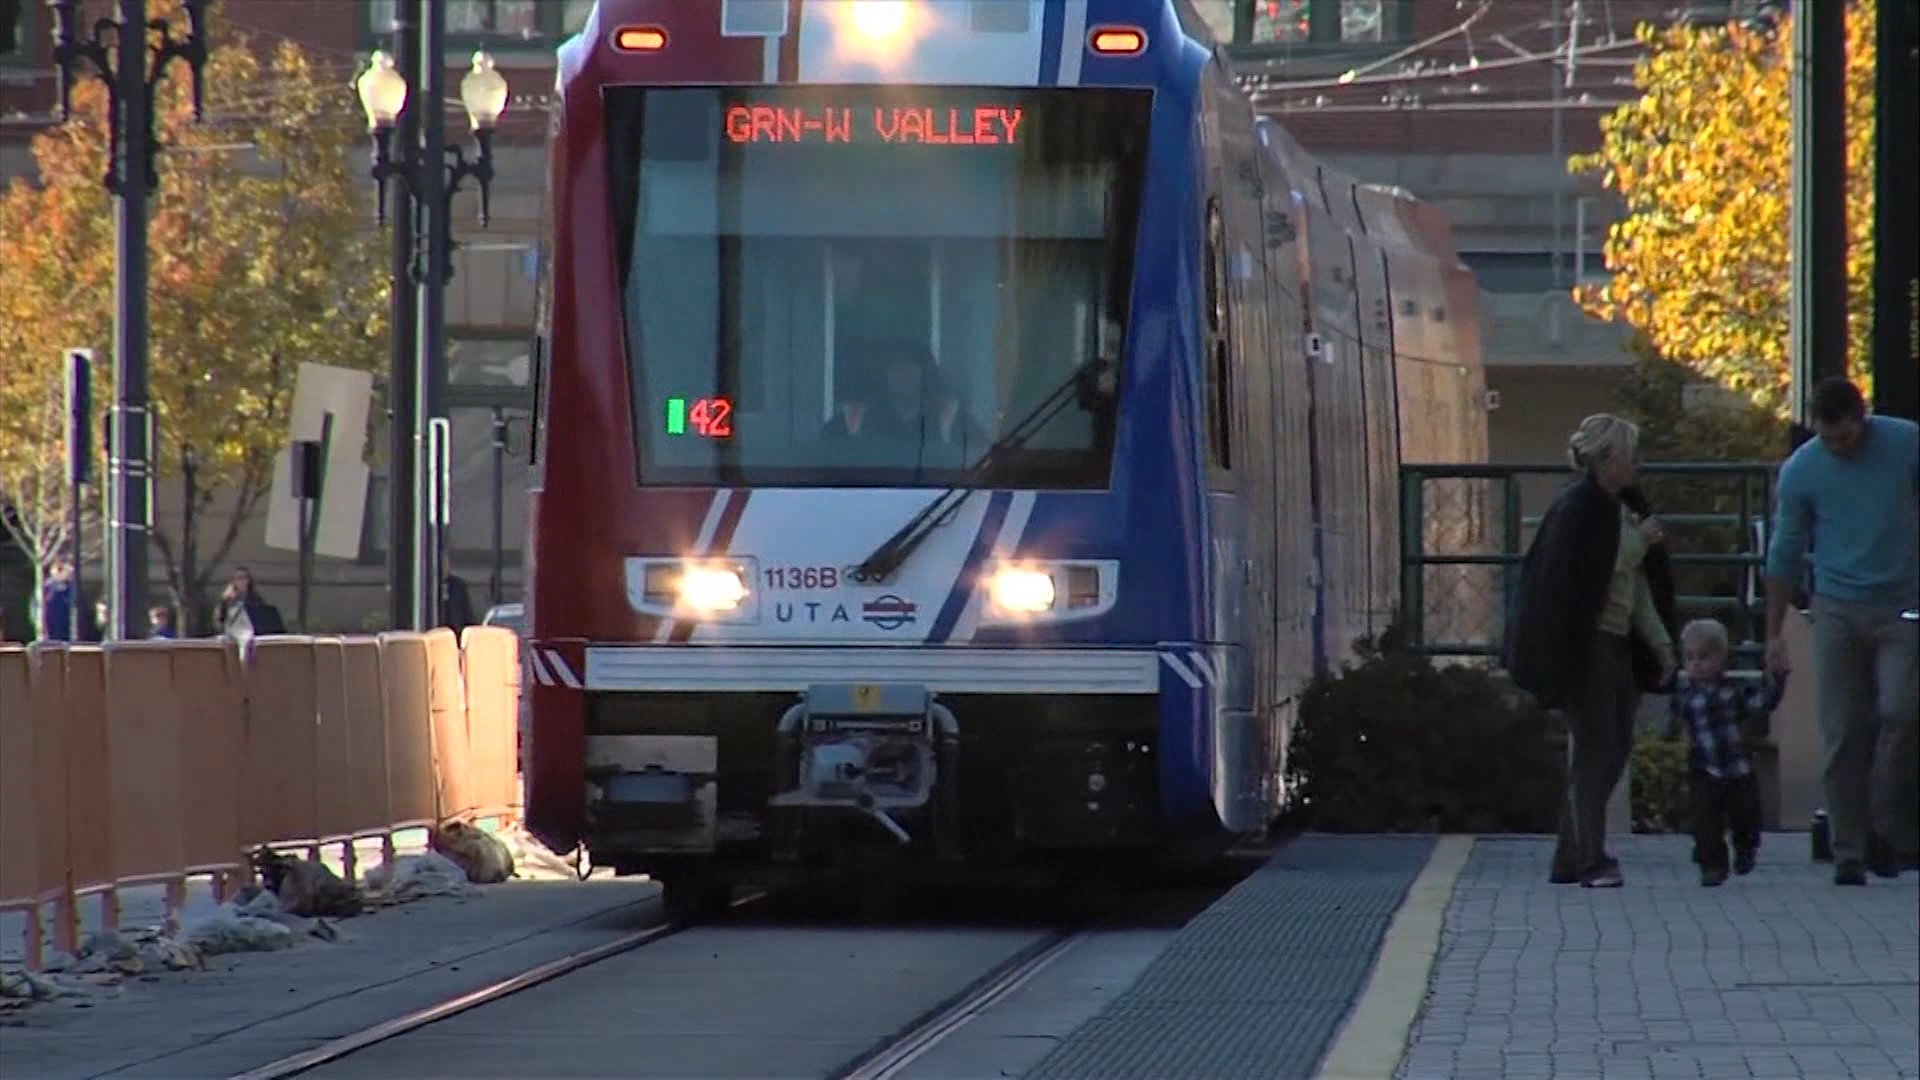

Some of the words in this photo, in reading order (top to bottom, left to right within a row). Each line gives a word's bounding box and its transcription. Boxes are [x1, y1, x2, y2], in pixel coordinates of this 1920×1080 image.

[726, 105, 852, 143] GRN-W
[874, 106, 1022, 144] VALLEY
[690, 398, 731, 437] 42
[765, 566, 838, 588] 1136B
[776, 603, 849, 622] UTA
